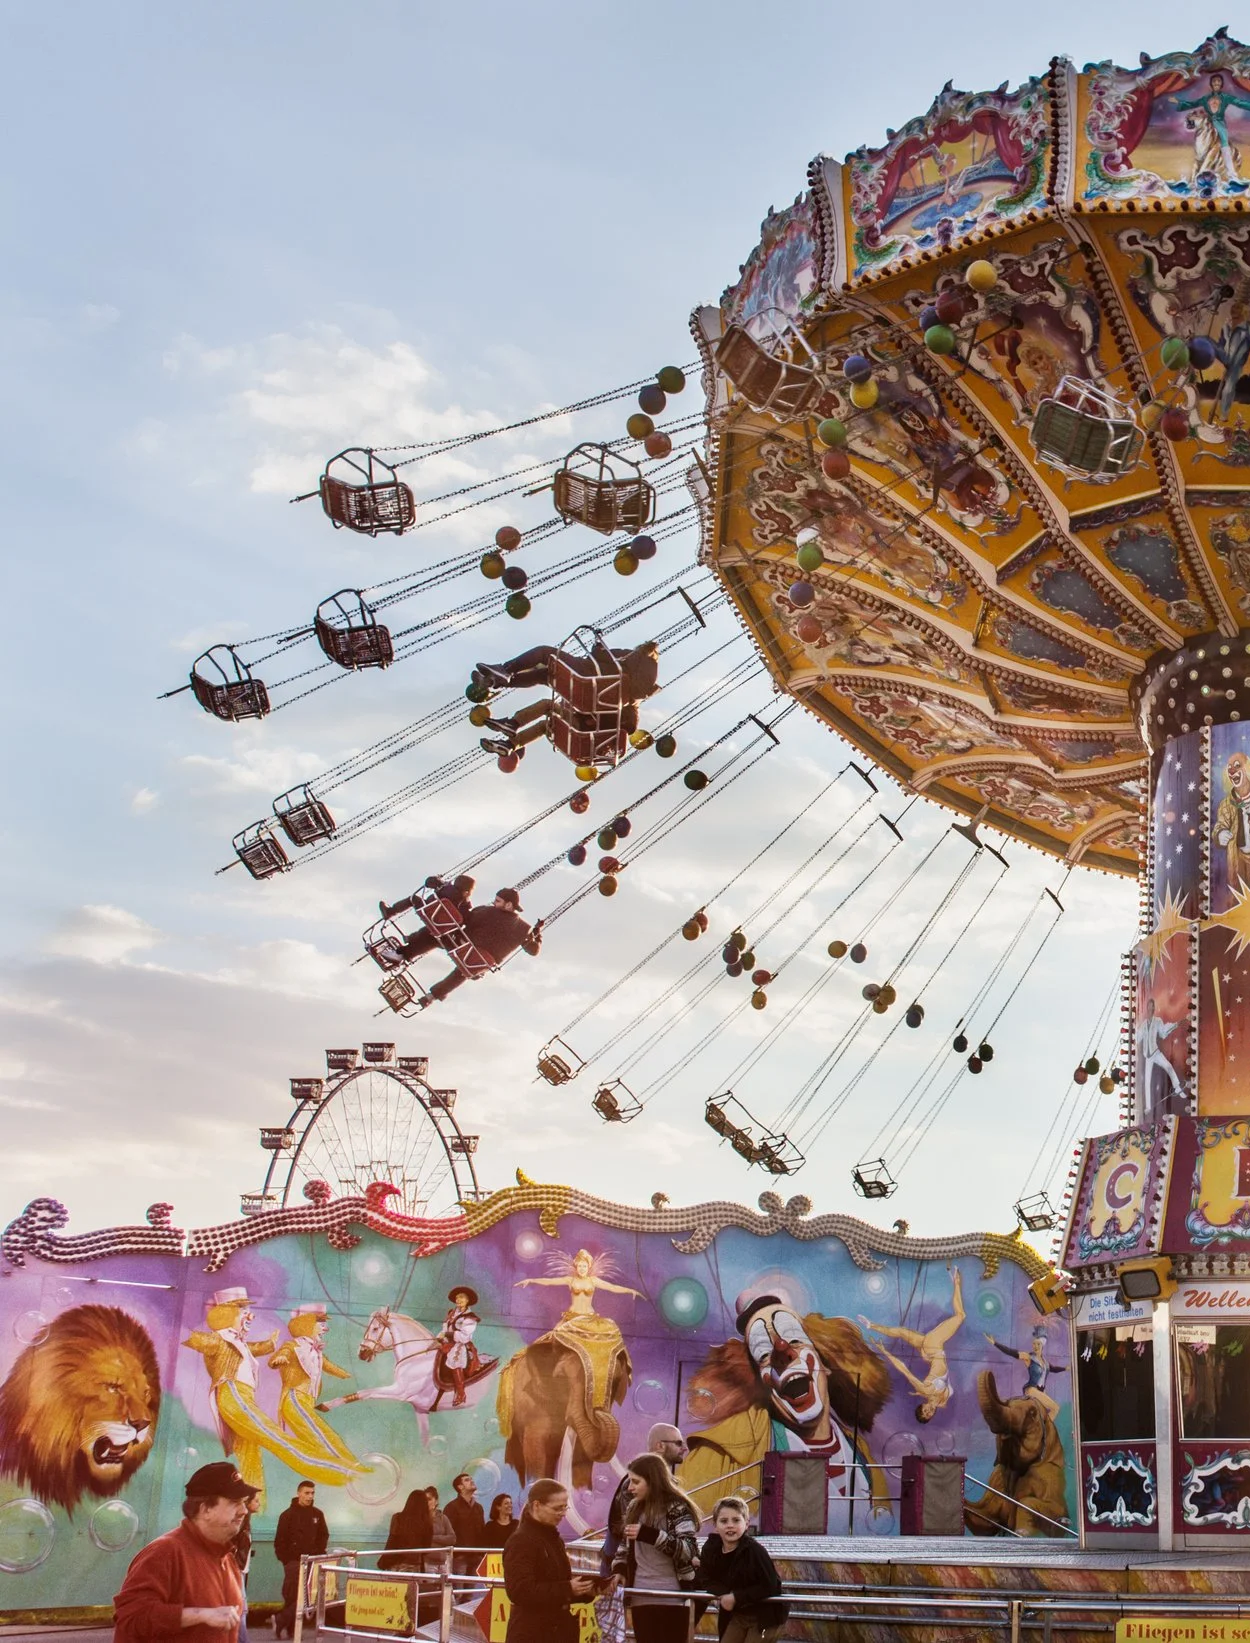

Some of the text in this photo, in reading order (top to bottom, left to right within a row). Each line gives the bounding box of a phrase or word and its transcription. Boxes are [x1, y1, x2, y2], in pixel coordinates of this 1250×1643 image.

[1105, 1163, 1139, 1210] C
[1090, 1297, 1102, 1310] Die
[1088, 1310, 1105, 1322] nicht
[349, 1583, 370, 1599] Fliegen
[1125, 1624, 1196, 1643] Fliegen
[1202, 1625, 1225, 1640] ist
